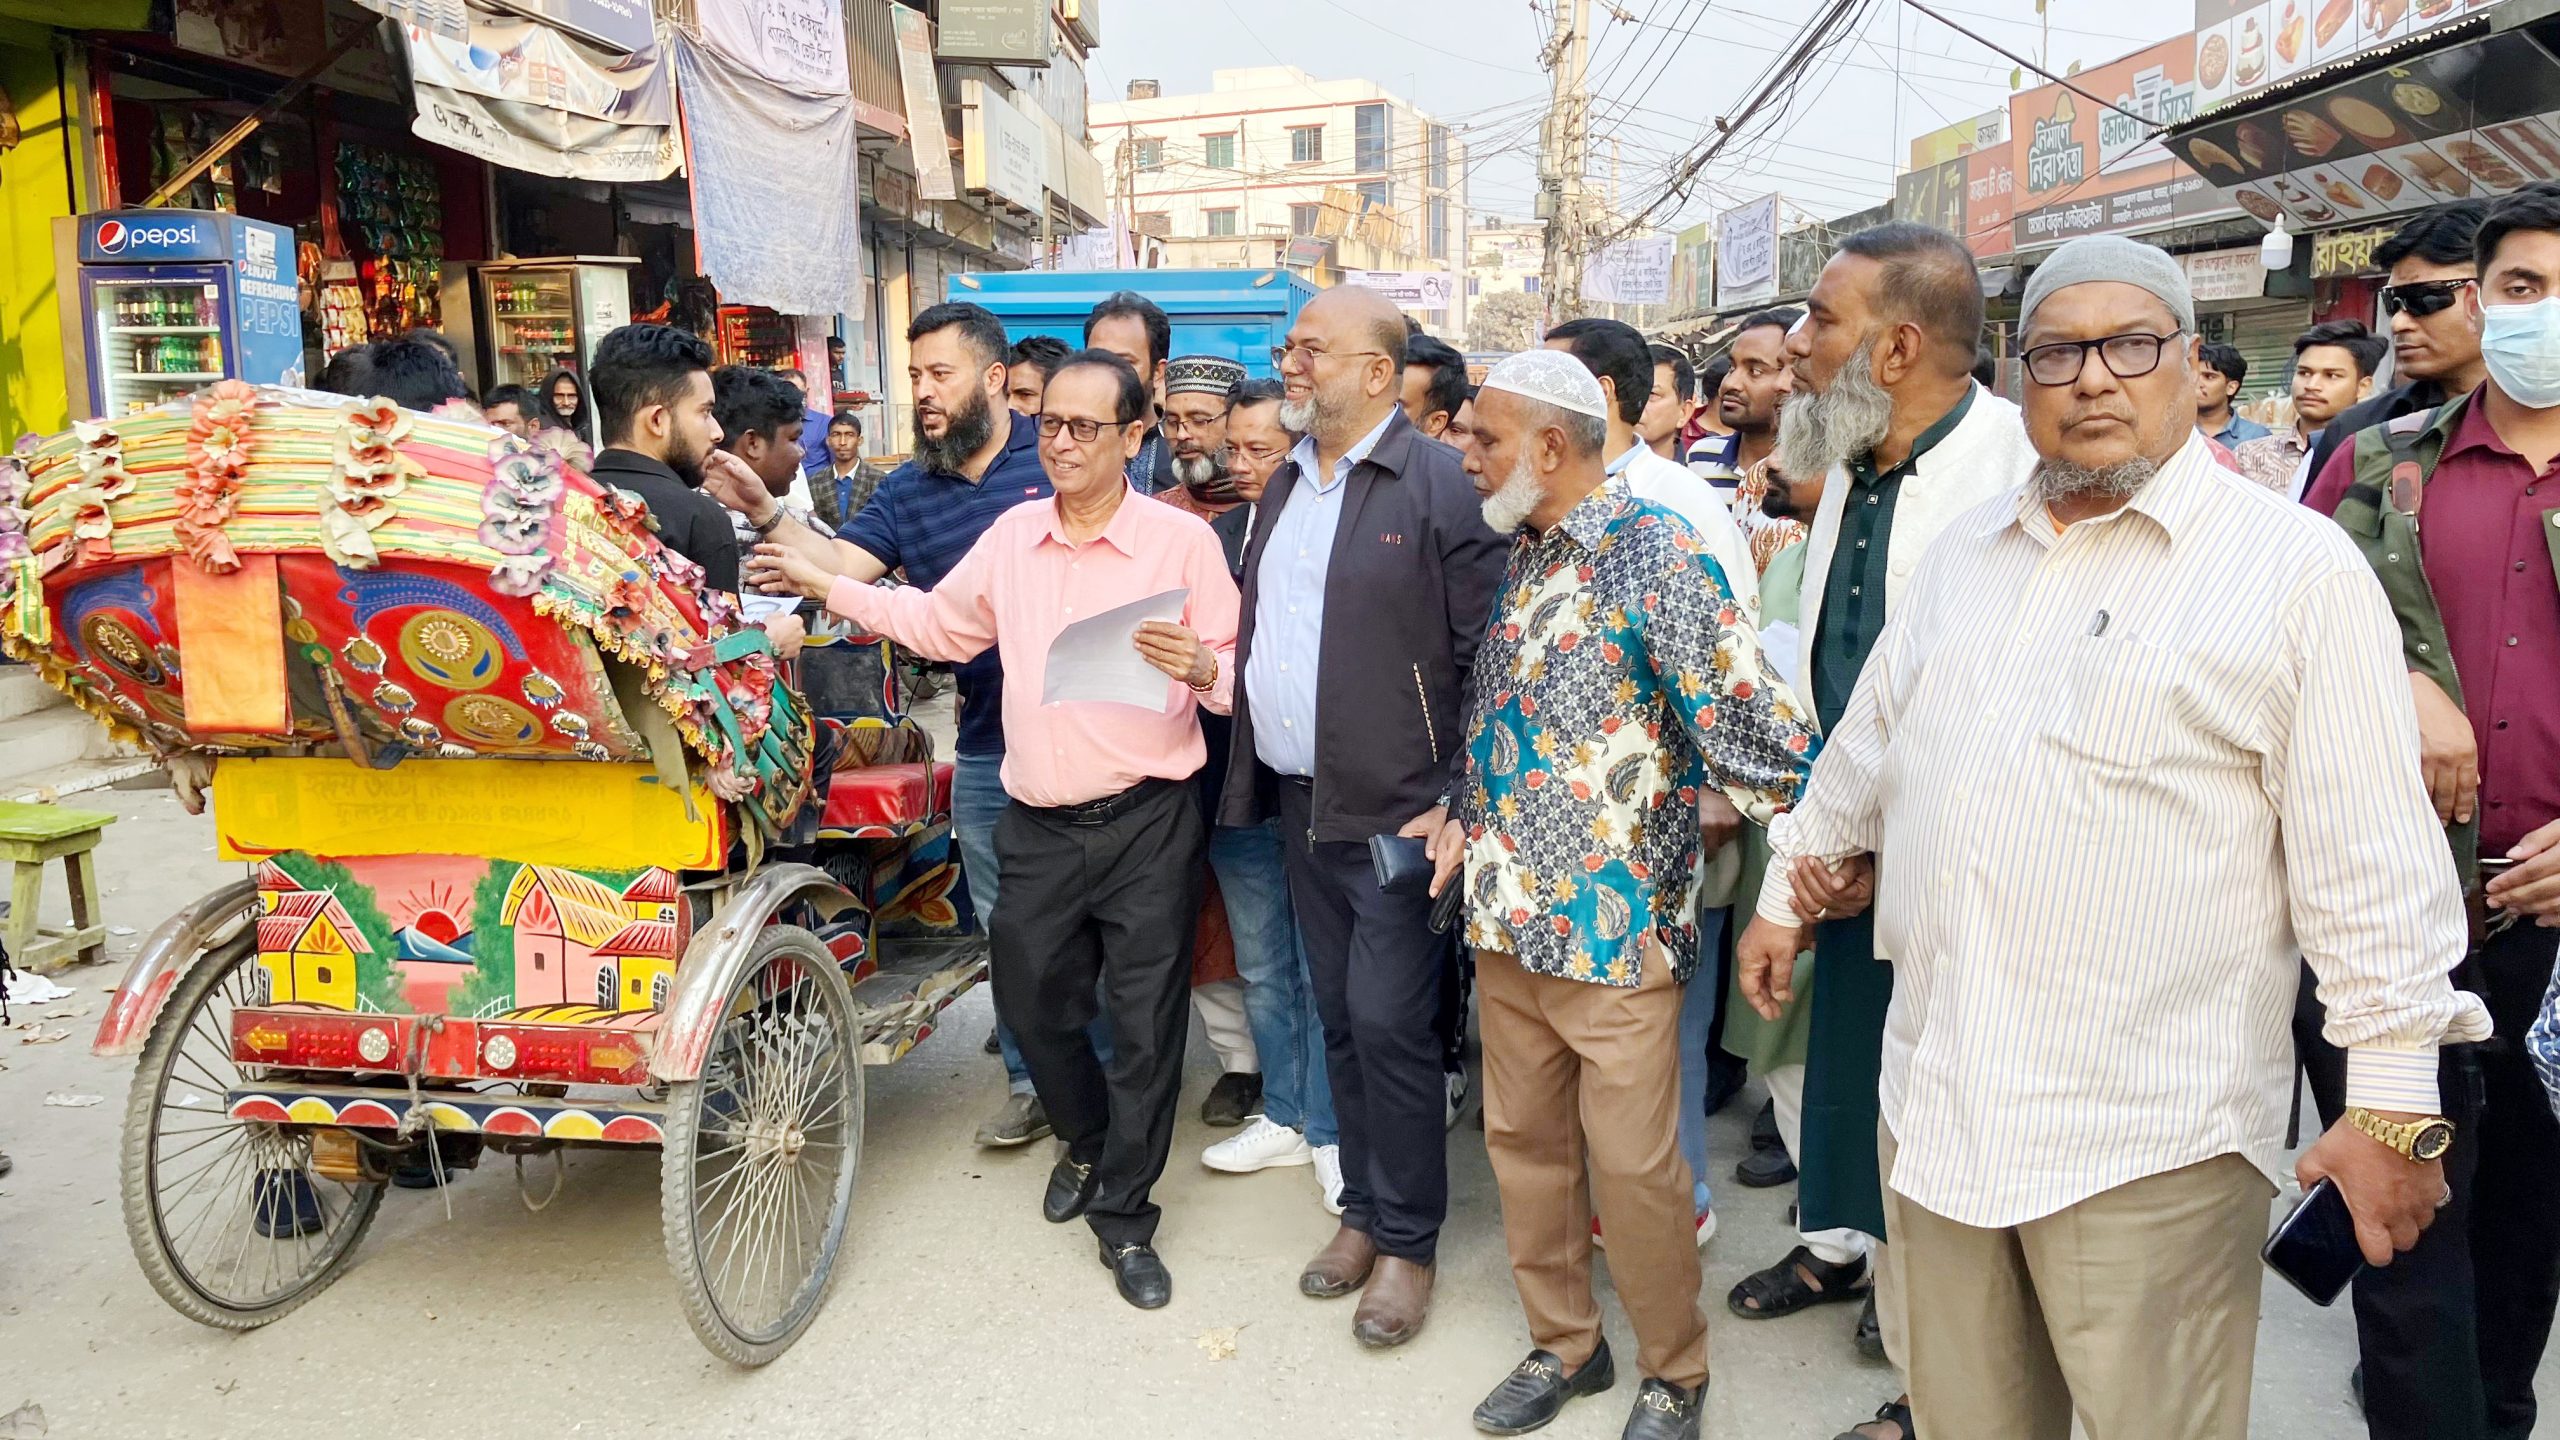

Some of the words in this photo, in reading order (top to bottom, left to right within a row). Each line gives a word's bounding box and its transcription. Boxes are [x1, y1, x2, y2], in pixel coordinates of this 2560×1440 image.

[2158, 87, 2193, 123] সিমে
[2035, 117, 2071, 151] নির্মাণে
[2029, 146, 2083, 190] নিরাপত্তা
[131, 225, 196, 248] pepsi
[240, 279, 298, 302] REFRESHING
[241, 297, 299, 338] PEPSI
